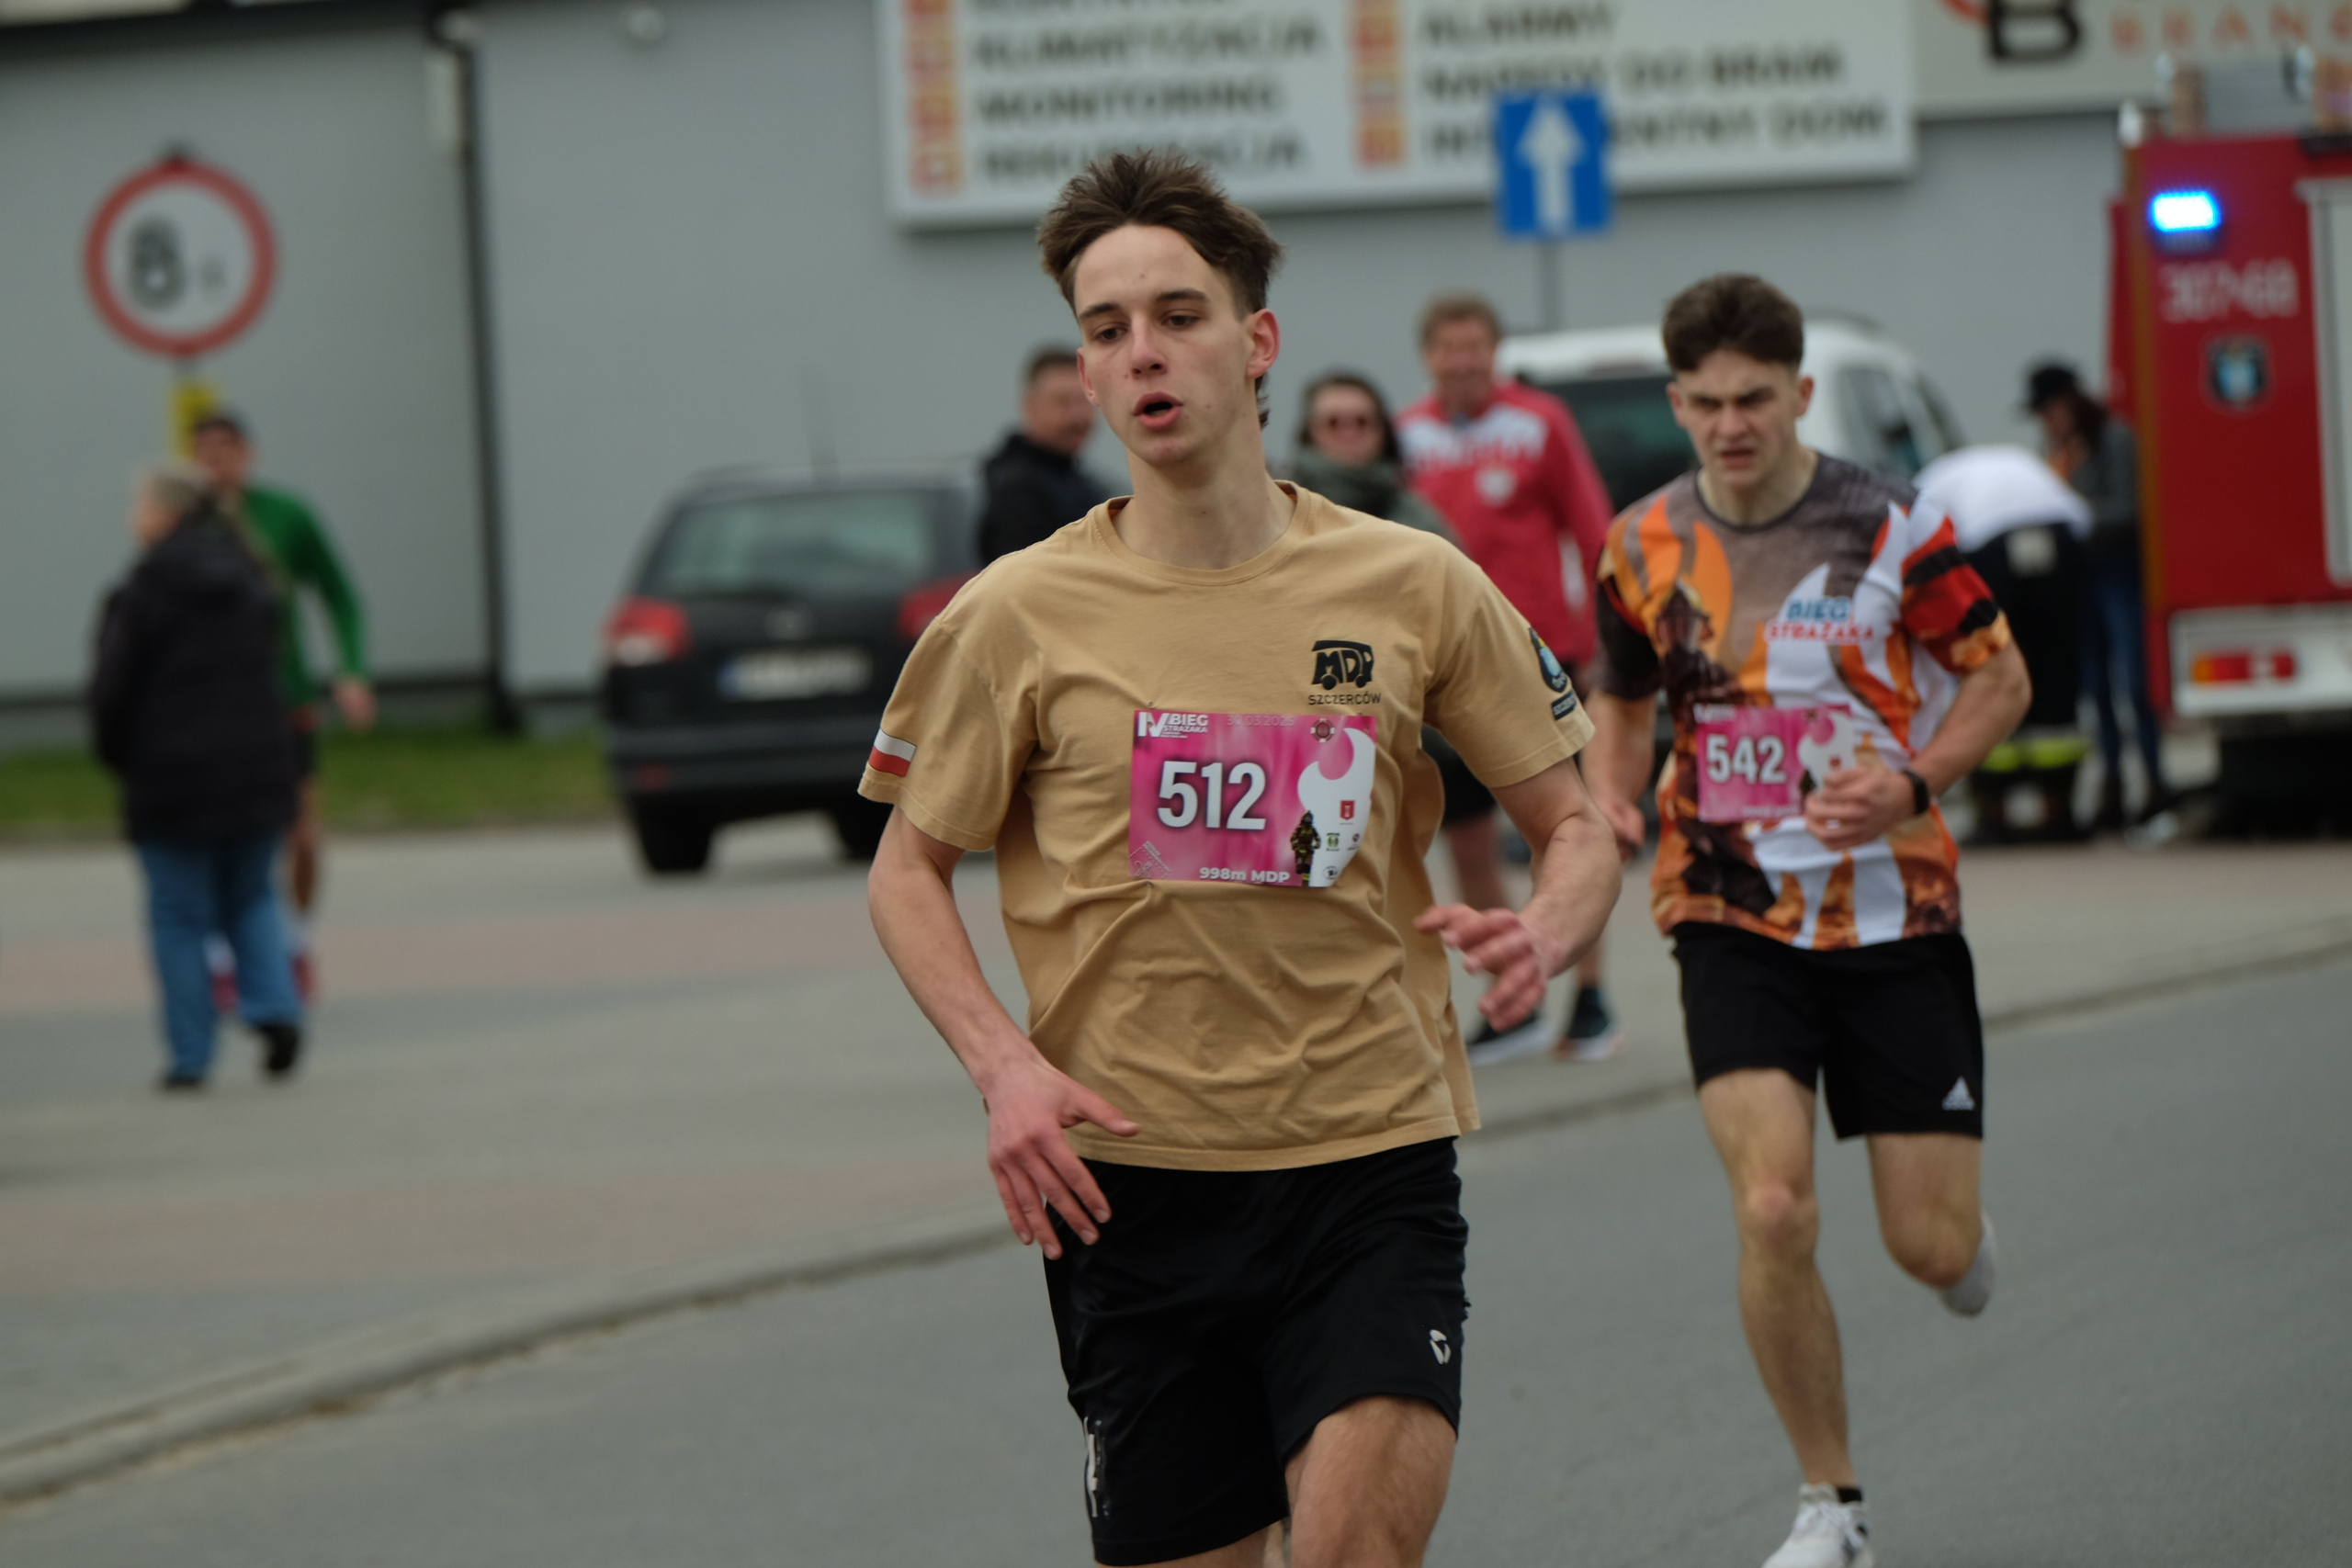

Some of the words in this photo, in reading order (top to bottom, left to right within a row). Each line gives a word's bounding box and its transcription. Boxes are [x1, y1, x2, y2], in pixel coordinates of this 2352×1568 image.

[1787, 598, 1849, 622] BIEG
[1307, 691, 1381, 705] SZCZERCÓW
[1168, 713, 1209, 727] BIEG
[1227, 715, 1296, 727] 30.03.2025
[1706, 733, 1787, 784] 542
[1157, 760, 1267, 830] 512
[1199, 867, 1247, 881] 998m
[1250, 870, 1291, 884] MDP
